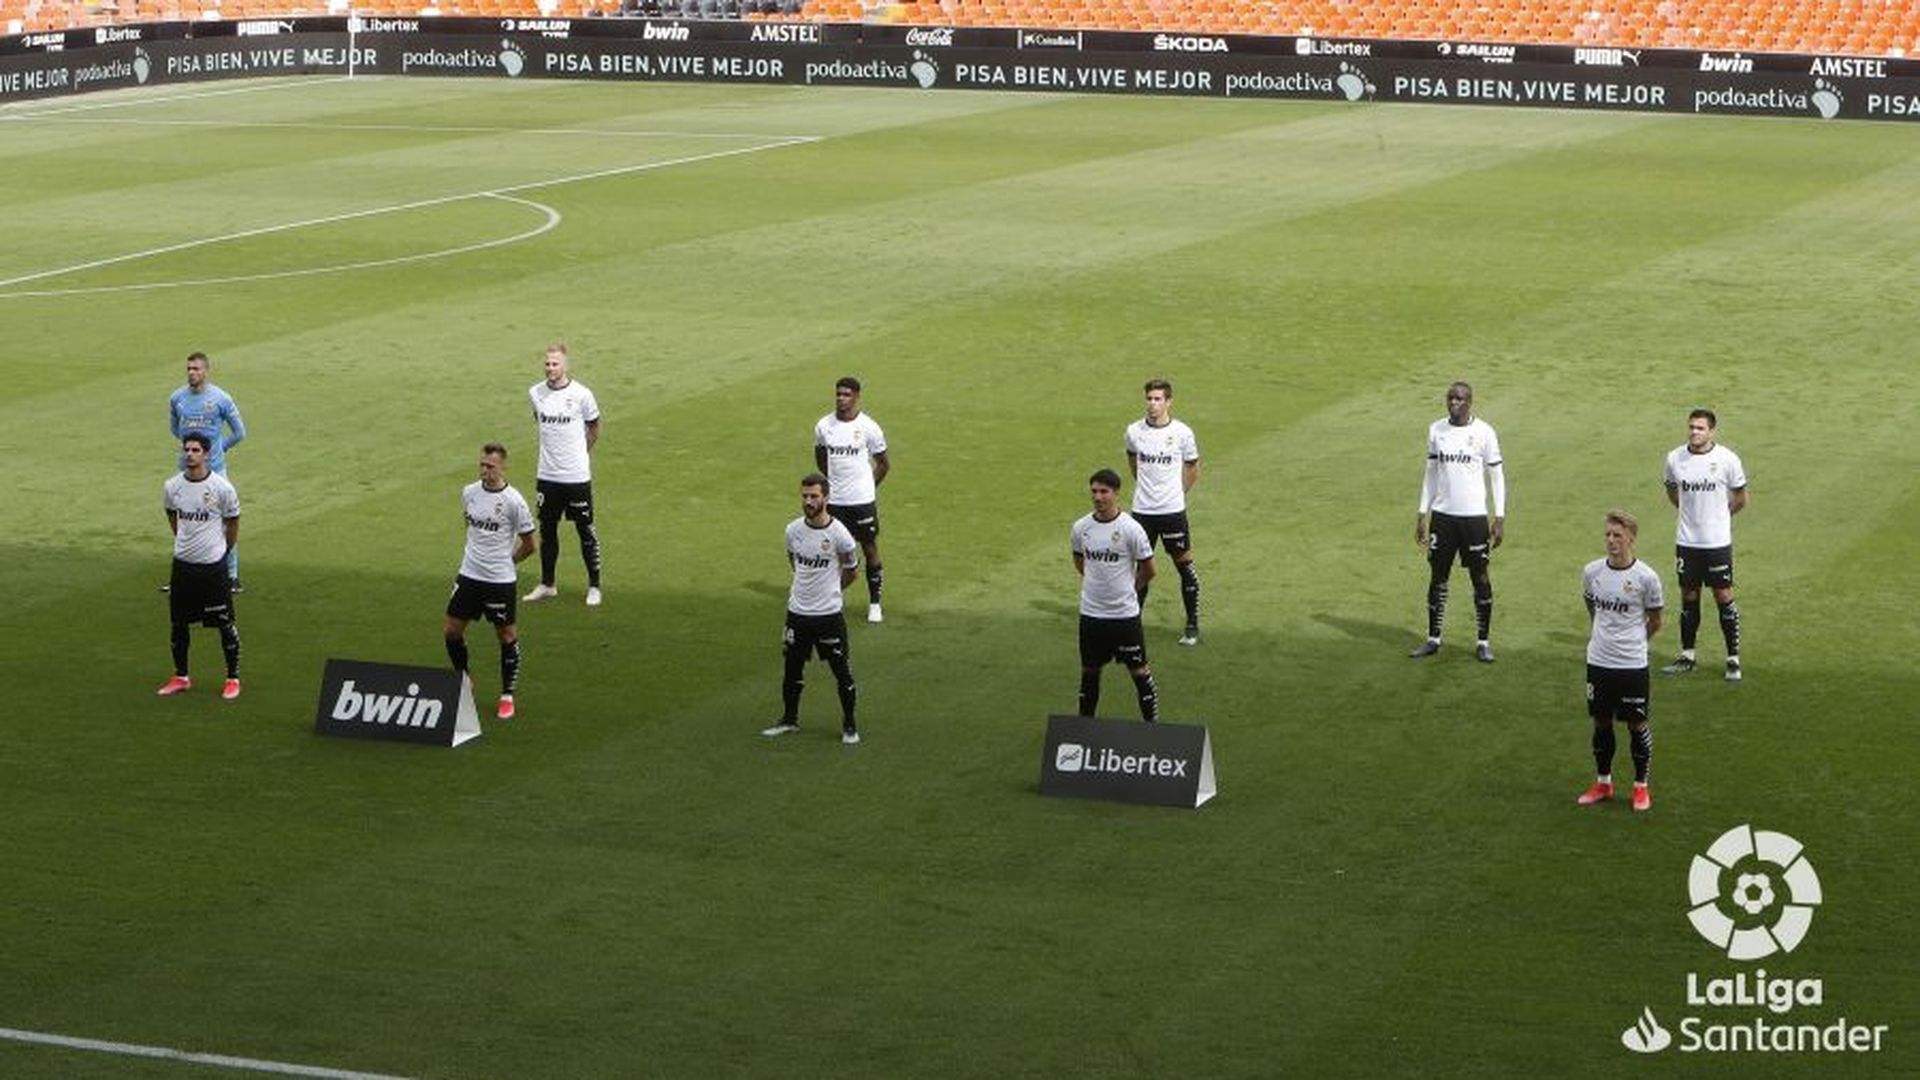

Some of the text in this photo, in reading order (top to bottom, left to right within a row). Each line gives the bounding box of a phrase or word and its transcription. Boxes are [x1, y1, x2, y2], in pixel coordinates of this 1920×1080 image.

[362, 20, 419, 32] Libertex
[643, 22, 690, 41] bwin
[751, 25, 818, 42] AMSTEL
[1154, 33, 1229, 52] ŠKODA
[1311, 41, 1371, 56] Libertex
[1456, 44, 1516, 57] SAILUN
[167, 55, 201, 75] PISA
[303, 48, 377, 66] MEJOR
[403, 49, 497, 73] podoactiva
[545, 53, 594, 72] PISA
[713, 57, 784, 77] MEJOR
[1574, 48, 1624, 65] PUMA
[1700, 53, 1753, 72] bwin
[74, 59, 131, 90] podoactiva
[806, 60, 908, 84] podoactiva
[956, 64, 1006, 84] PISA
[1135, 70, 1212, 89] MEJOR
[1809, 57, 1886, 78] AMSTEL
[25, 68, 69, 90] MEJOR
[1226, 72, 1333, 96] podoactiva
[1394, 76, 1448, 97] PISA
[1585, 83, 1666, 105] MEJOR
[1695, 87, 1808, 112] podoactiva
[1867, 94, 1920, 115] PISA
[1439, 450, 1472, 464] bwin
[1681, 478, 1716, 492] bwin
[332, 680, 443, 729] bwin
[1083, 748, 1188, 777] Libertex
